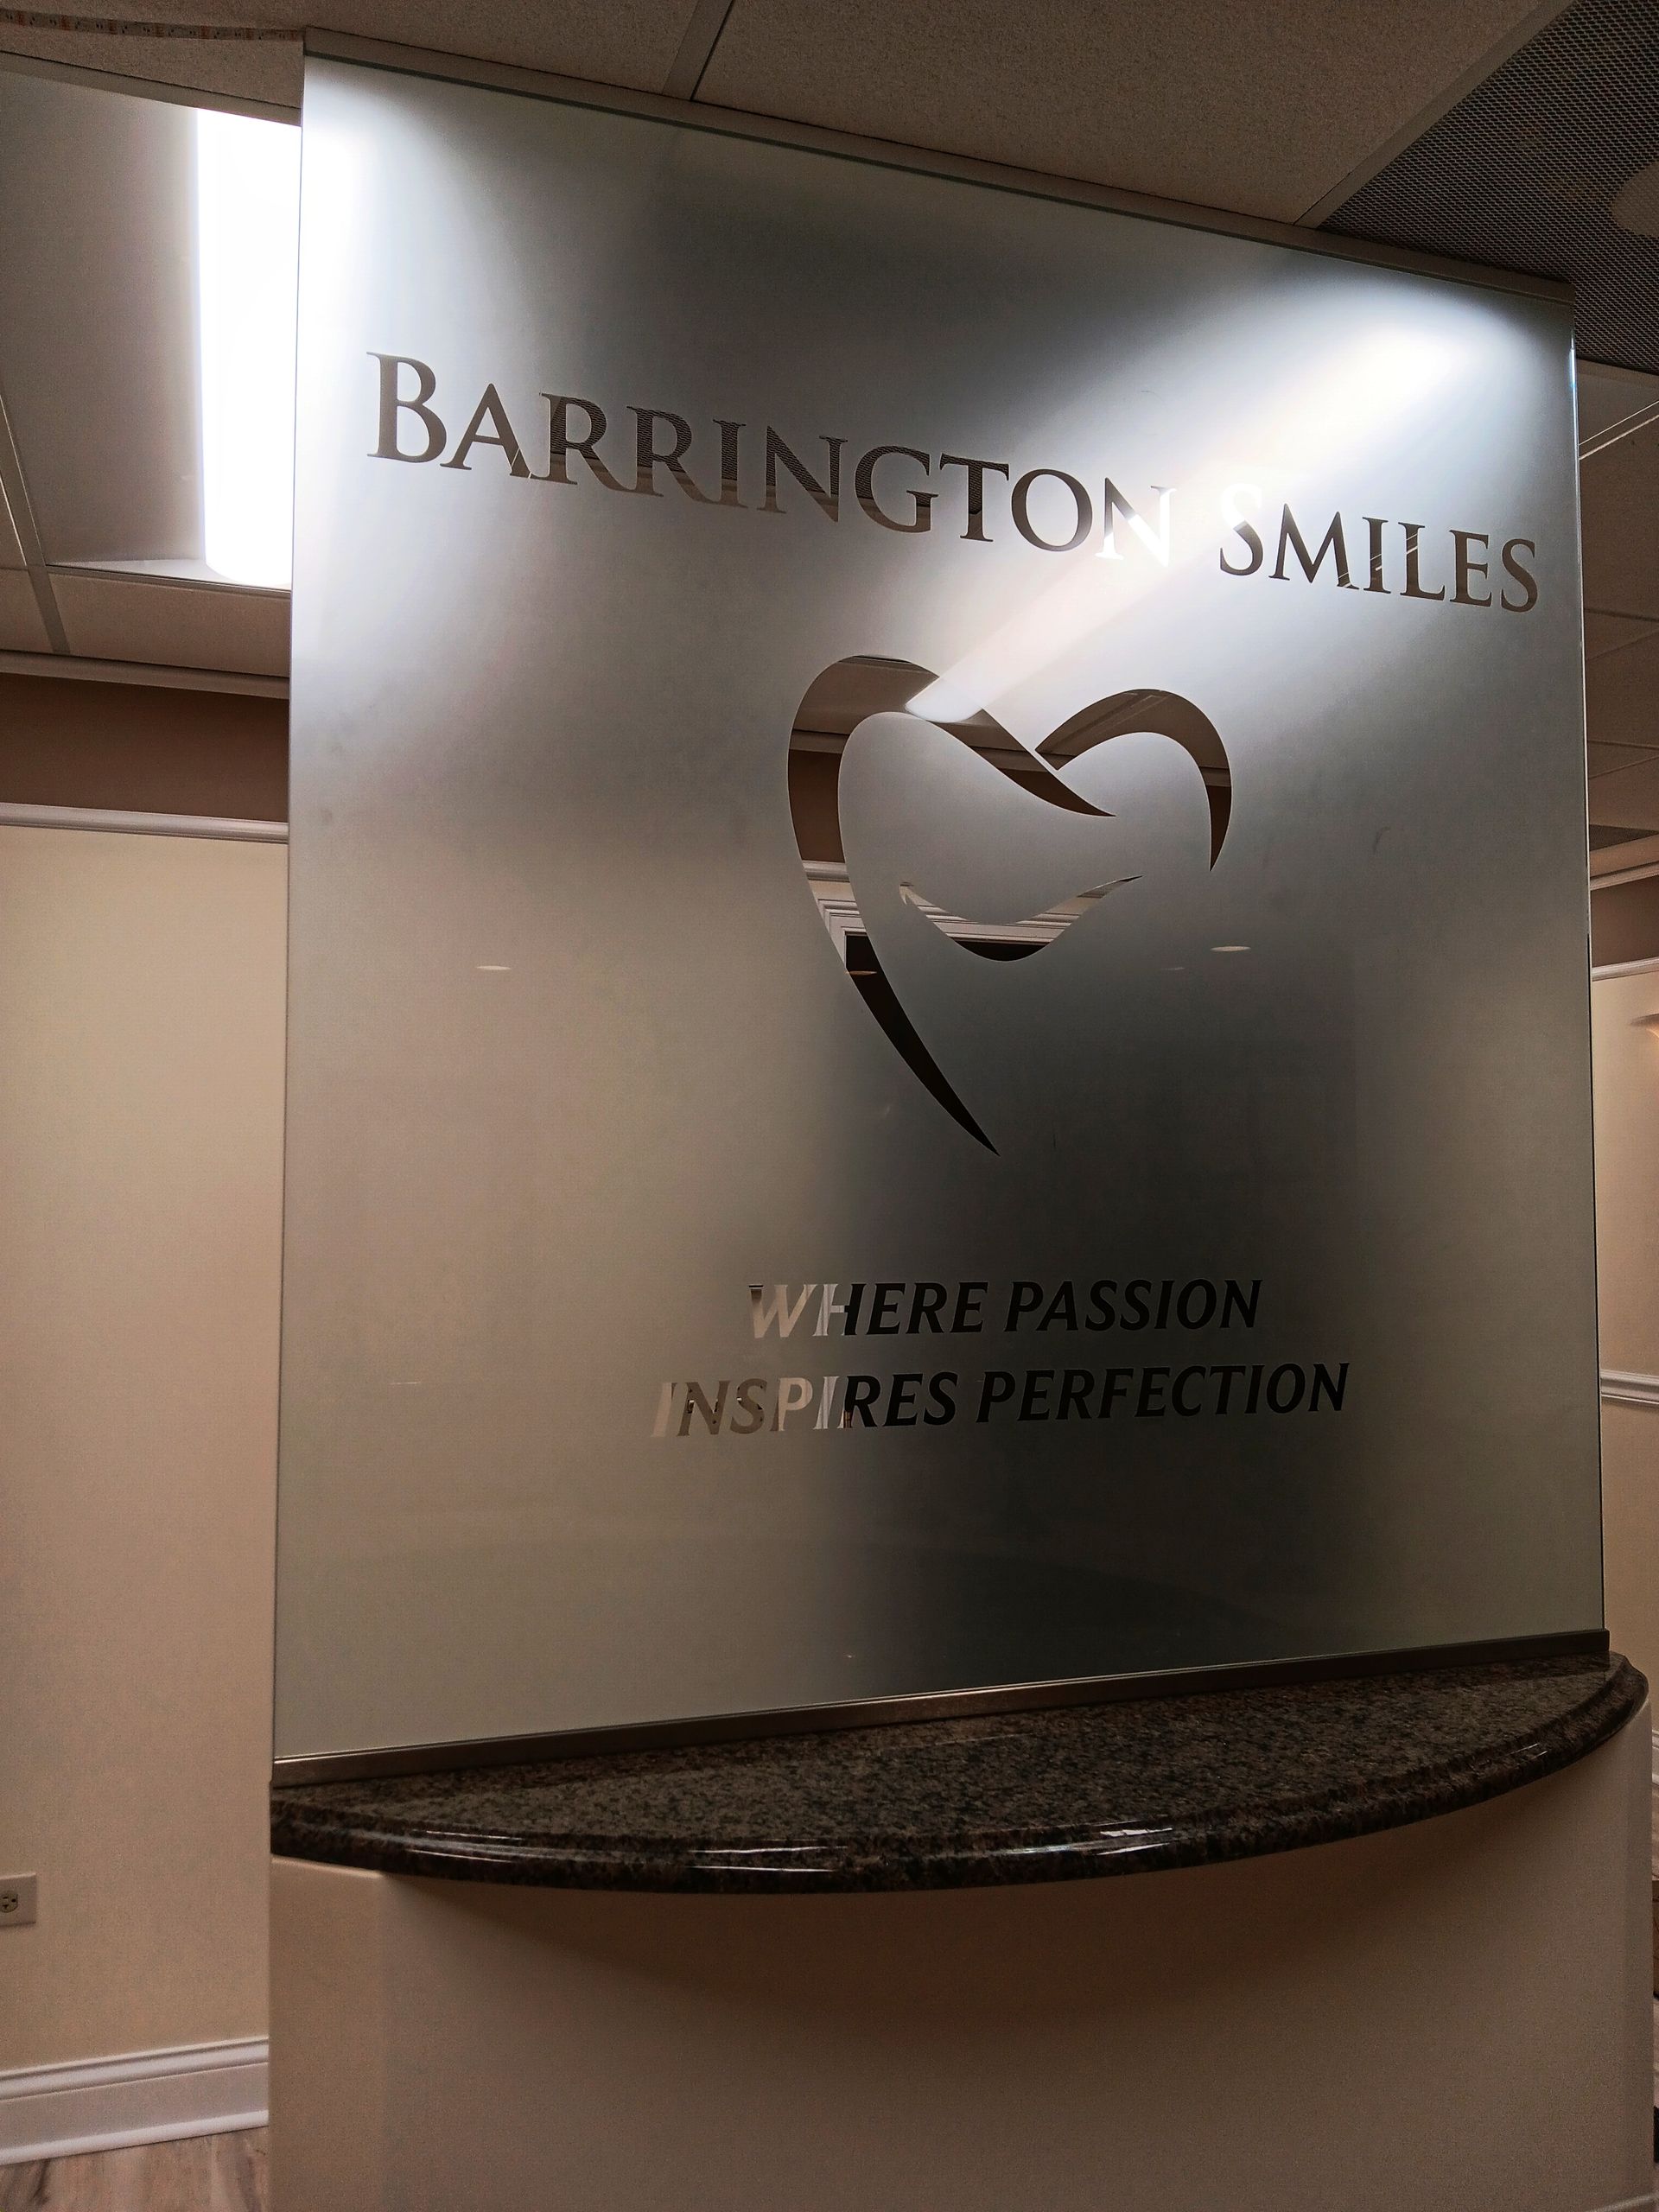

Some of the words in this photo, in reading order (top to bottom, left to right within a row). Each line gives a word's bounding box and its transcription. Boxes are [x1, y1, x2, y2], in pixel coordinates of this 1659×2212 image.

[366, 352, 1177, 567] BARRINGTON
[1219, 483, 1539, 612] SMILES
[749, 1281, 989, 1338] WHERE
[1004, 1278, 1262, 1332] PASSION
[651, 1373, 957, 1438] INSPIRES
[975, 1362, 1350, 1424] PERFECTION
